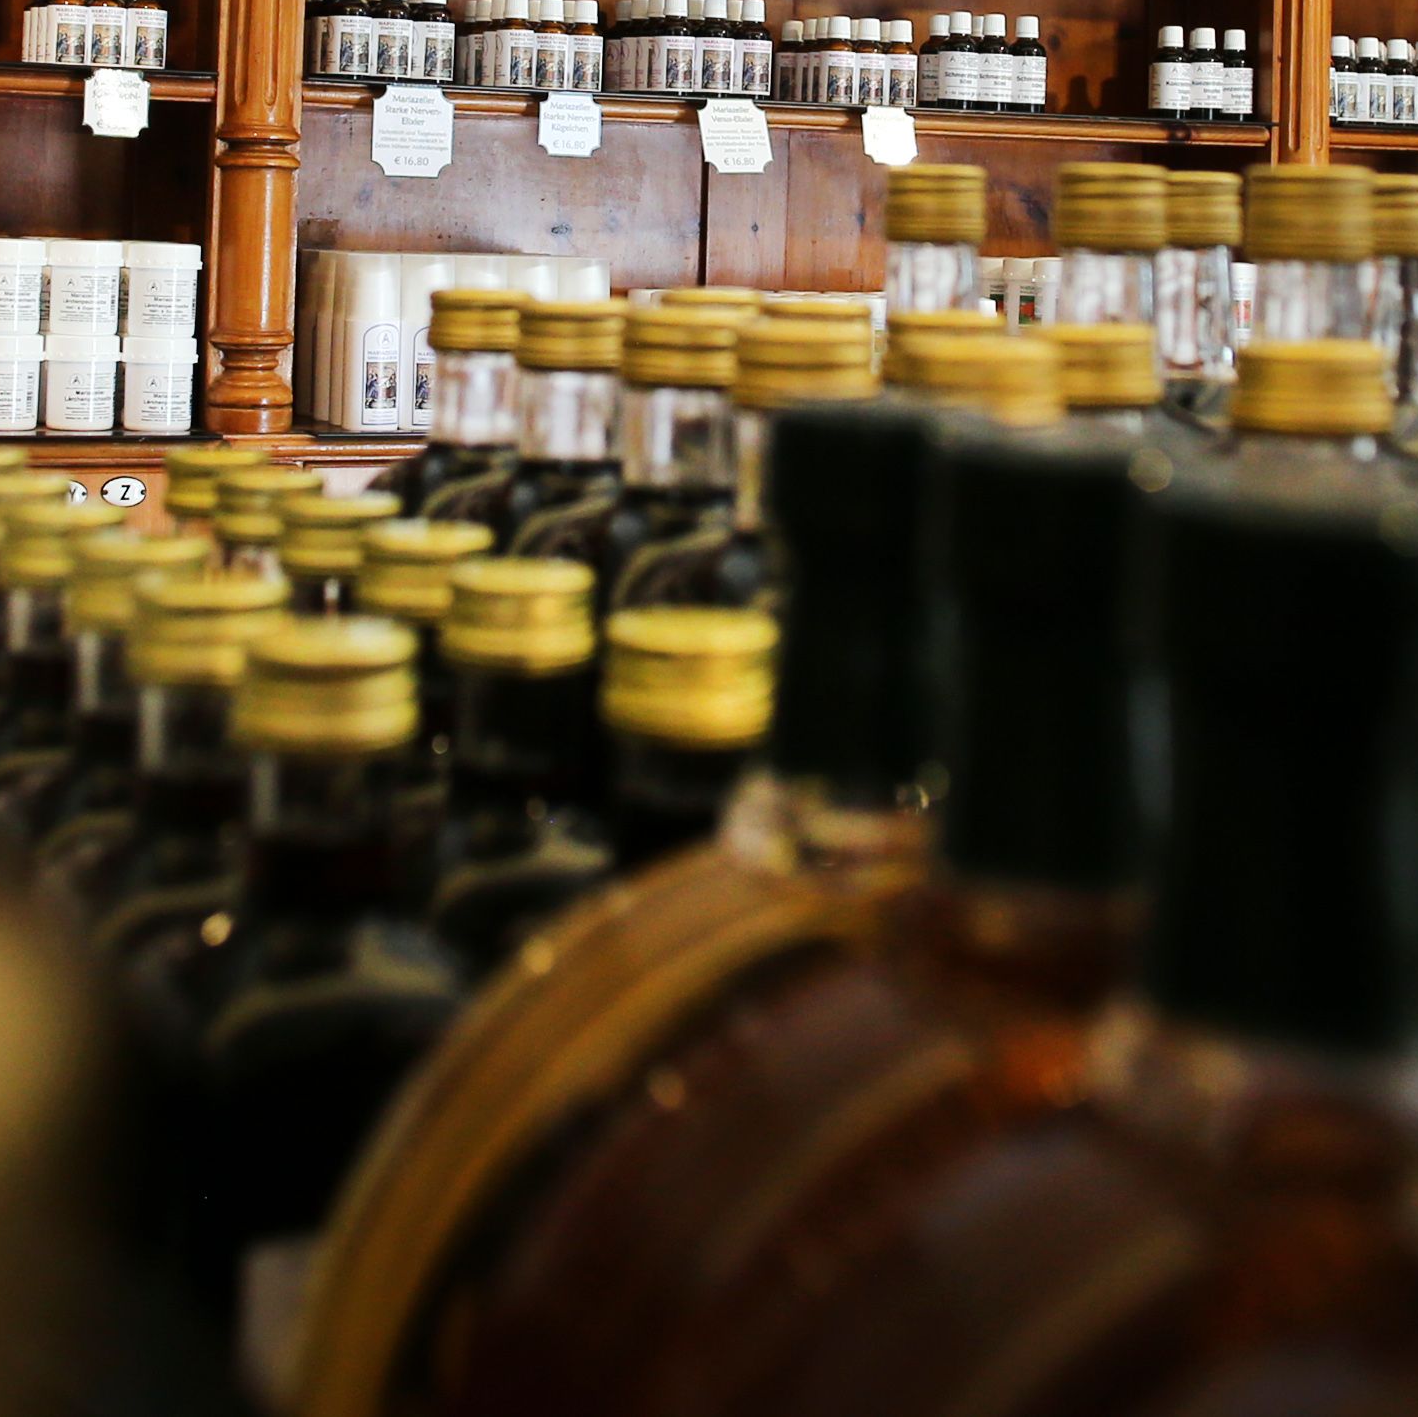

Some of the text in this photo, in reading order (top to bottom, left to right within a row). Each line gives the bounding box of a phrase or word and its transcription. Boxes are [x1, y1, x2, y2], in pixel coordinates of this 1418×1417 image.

[393, 93, 435, 104] Mariazeller
[384, 105, 442, 116] Starke Nerven-
[401, 116, 425, 125] Elixier
[120, 484, 131, 501] Z
